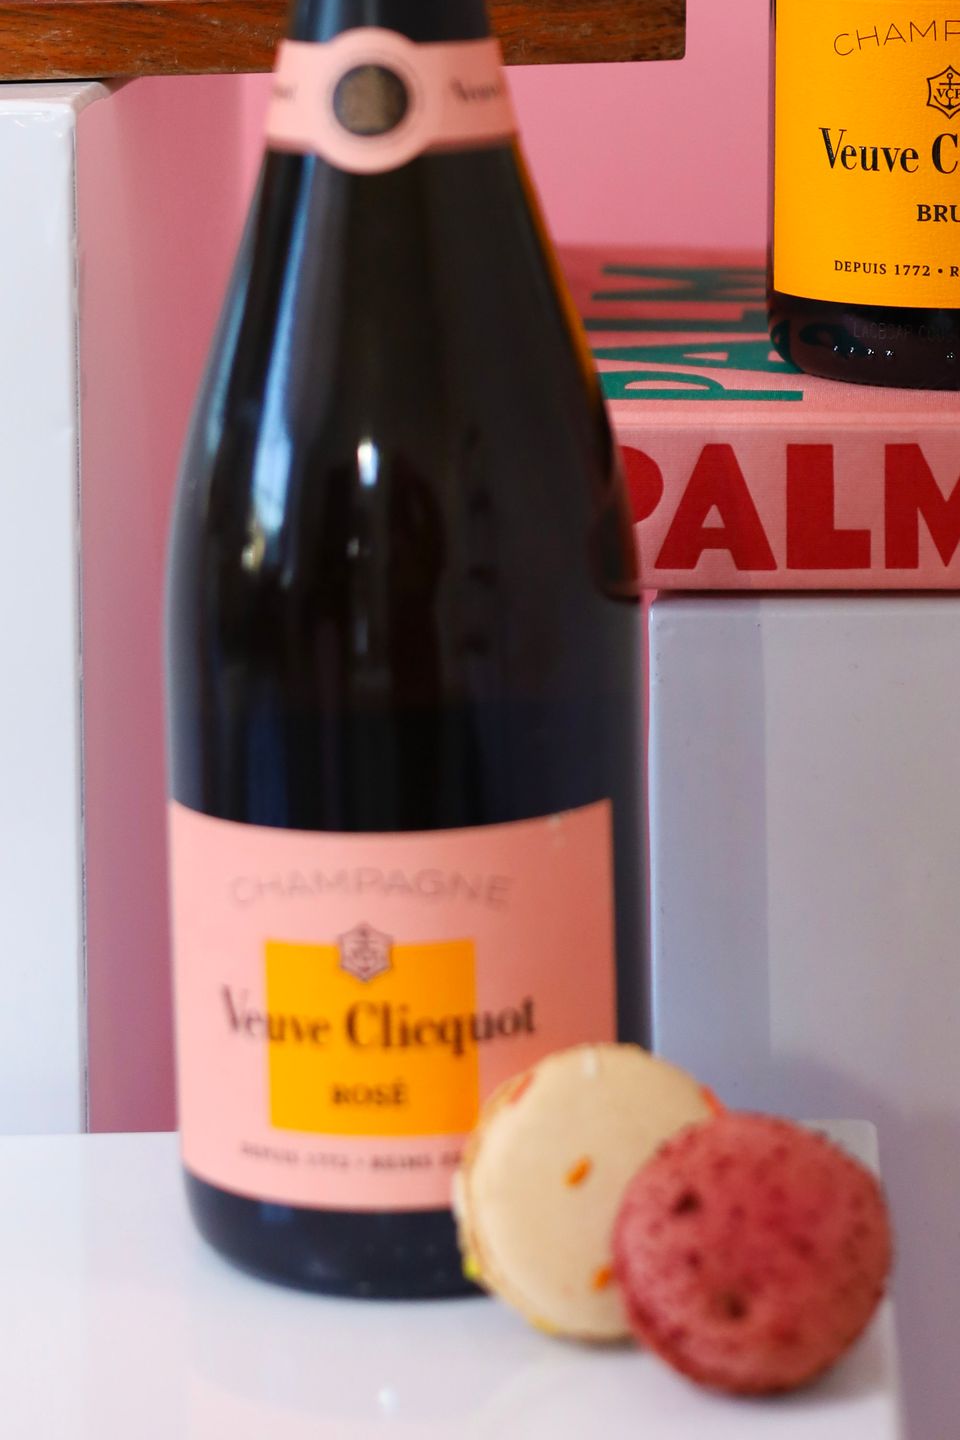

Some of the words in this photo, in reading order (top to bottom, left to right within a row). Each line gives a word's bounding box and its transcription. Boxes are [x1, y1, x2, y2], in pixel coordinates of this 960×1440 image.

[818, 127, 920, 174] Veuve
[834, 259, 887, 275] DEPUIS
[894, 264, 931, 277] 1772
[220, 984, 333, 1044] Veuve
[344, 995, 537, 1059] Clicquot
